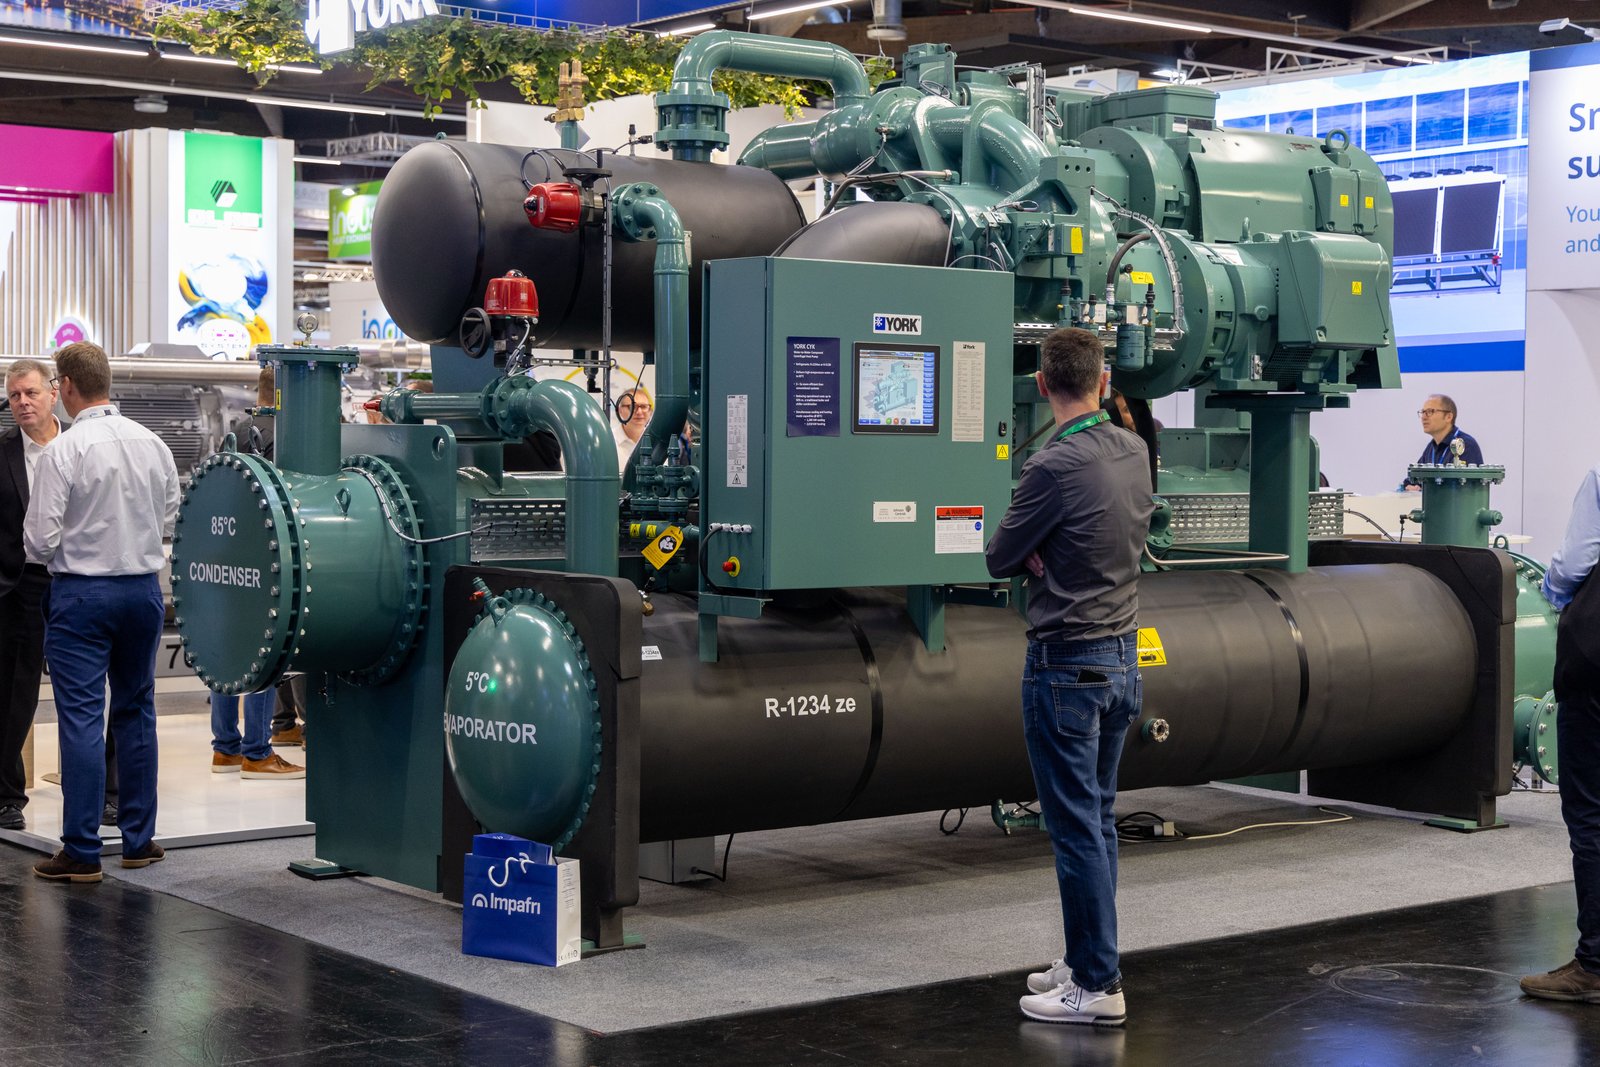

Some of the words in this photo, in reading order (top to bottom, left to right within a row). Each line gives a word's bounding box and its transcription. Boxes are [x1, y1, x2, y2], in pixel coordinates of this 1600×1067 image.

[886, 317, 918, 332] YORK
[211, 516, 236, 536] 85°C
[189, 561, 261, 588] CONDENSER
[465, 671, 489, 693] 5°C
[765, 694, 831, 718] R-1234
[835, 697, 857, 713] ze
[490, 892, 541, 915] Impafri
